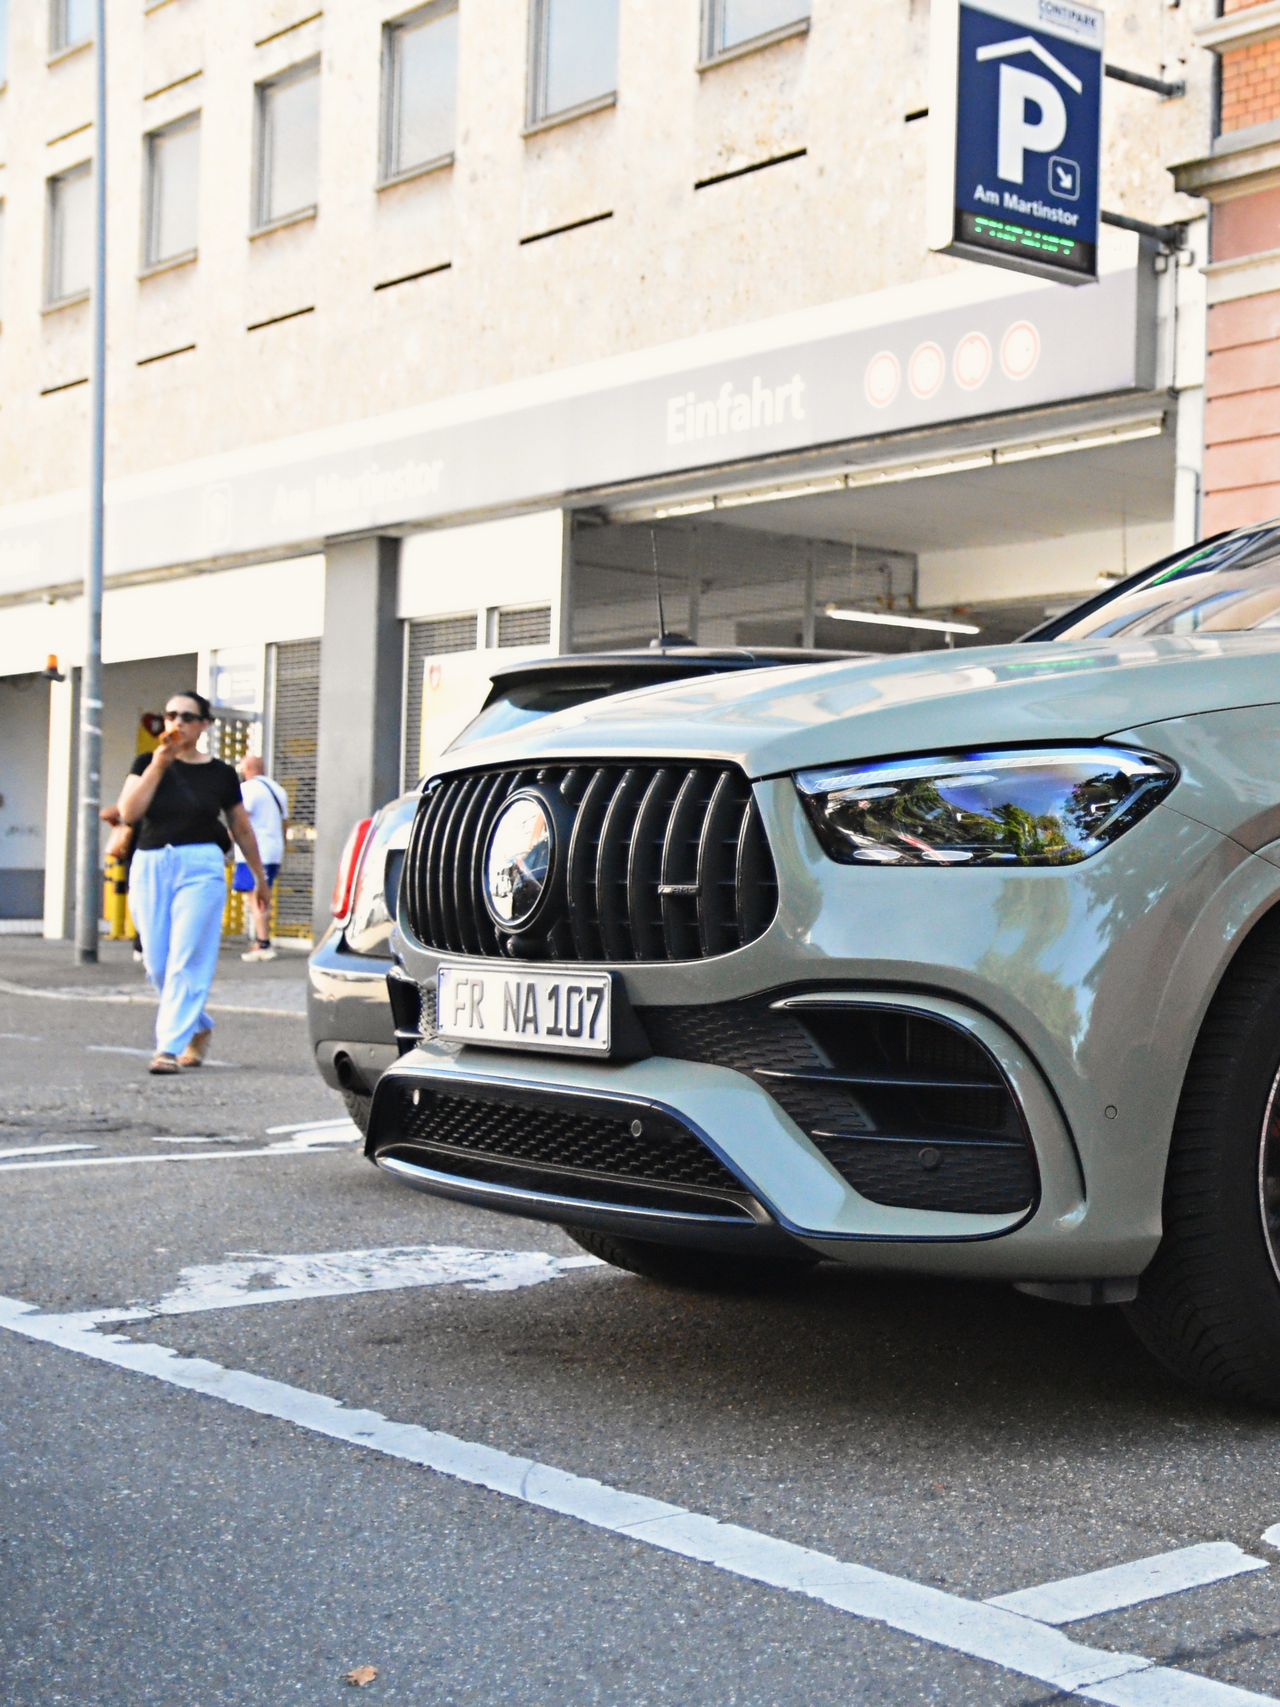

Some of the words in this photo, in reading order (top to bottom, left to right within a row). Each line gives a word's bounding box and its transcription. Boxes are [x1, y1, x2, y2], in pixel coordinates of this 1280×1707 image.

[997, 62, 1067, 185] P
[973, 183, 1000, 207] Am
[1003, 191, 1080, 227] Martinstor
[666, 373, 805, 446] Einfahrt
[315, 459, 444, 515] Martinstor
[453, 978, 485, 1029] FR
